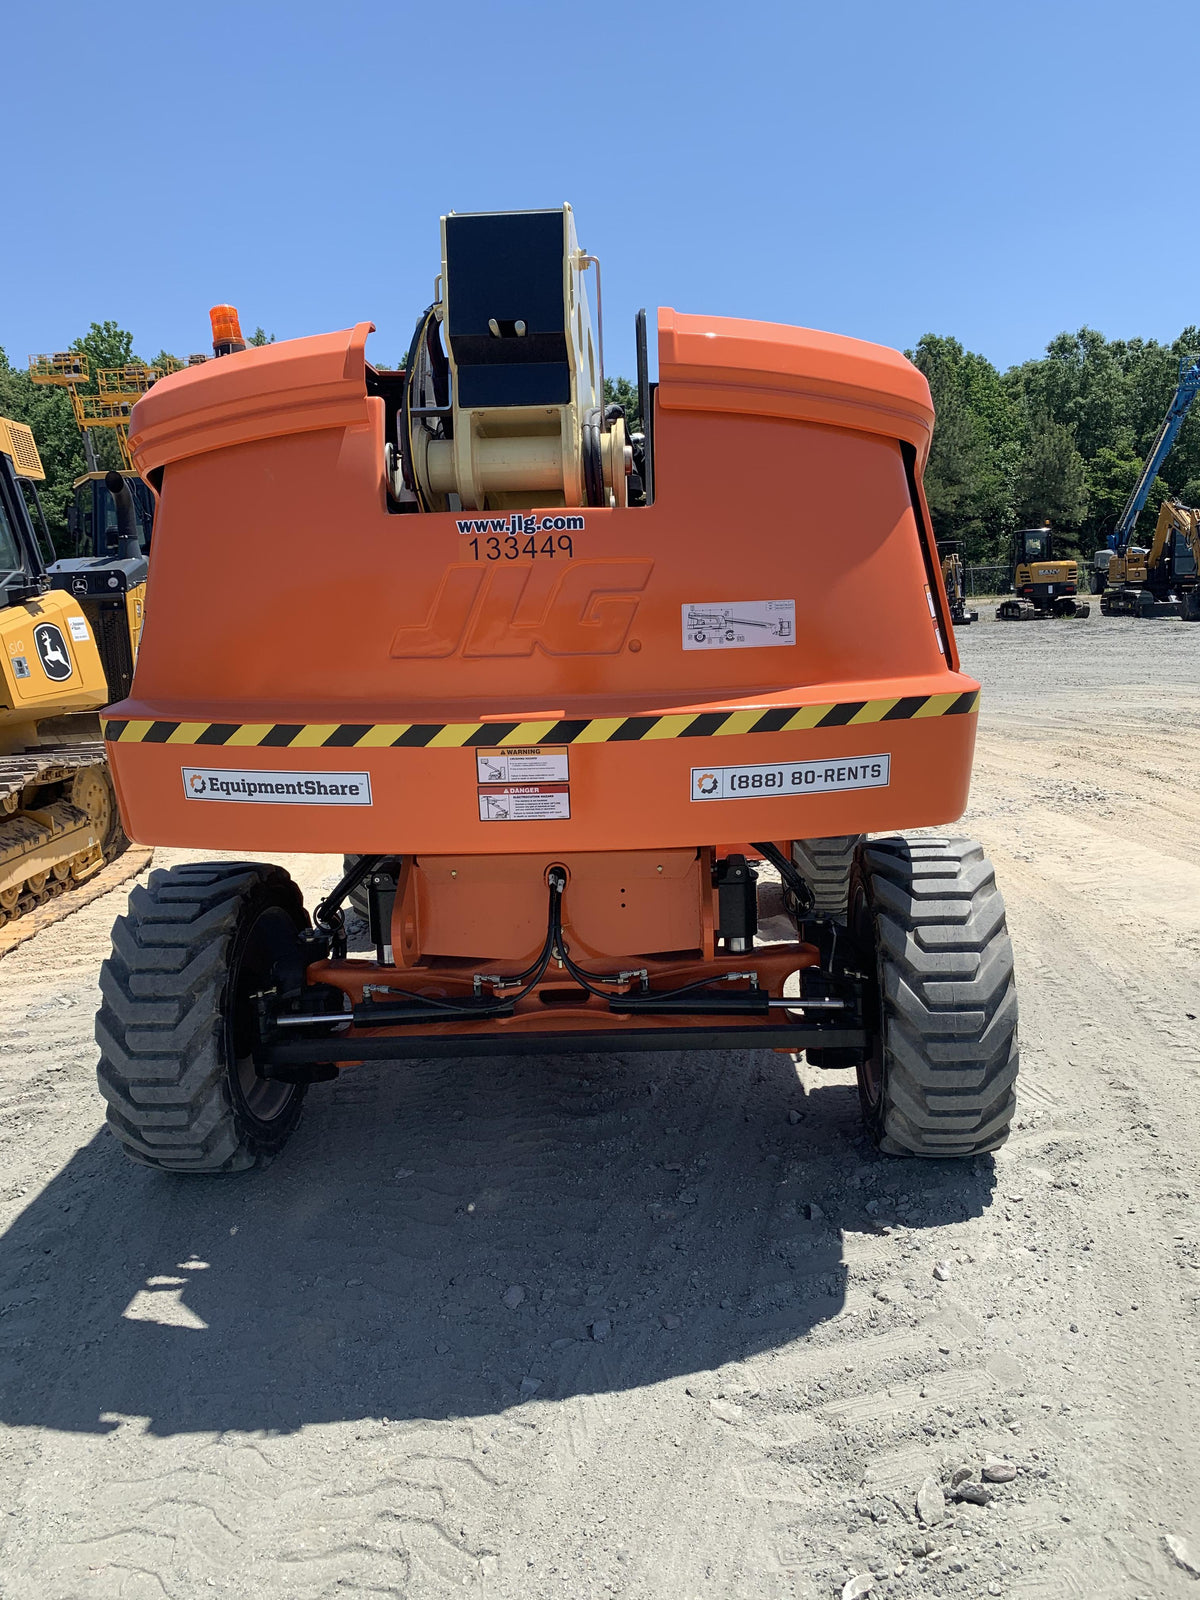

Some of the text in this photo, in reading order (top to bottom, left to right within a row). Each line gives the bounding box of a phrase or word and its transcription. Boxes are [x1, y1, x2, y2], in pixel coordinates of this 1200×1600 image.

[456, 514, 584, 535] www.jlg.com
[469, 535, 573, 560] 133449
[388, 558, 655, 660] JLG
[506, 748, 541, 756] WARNING
[208, 777, 360, 797] EquipmentShare
[730, 763, 882, 791] (888) 80-RENTS
